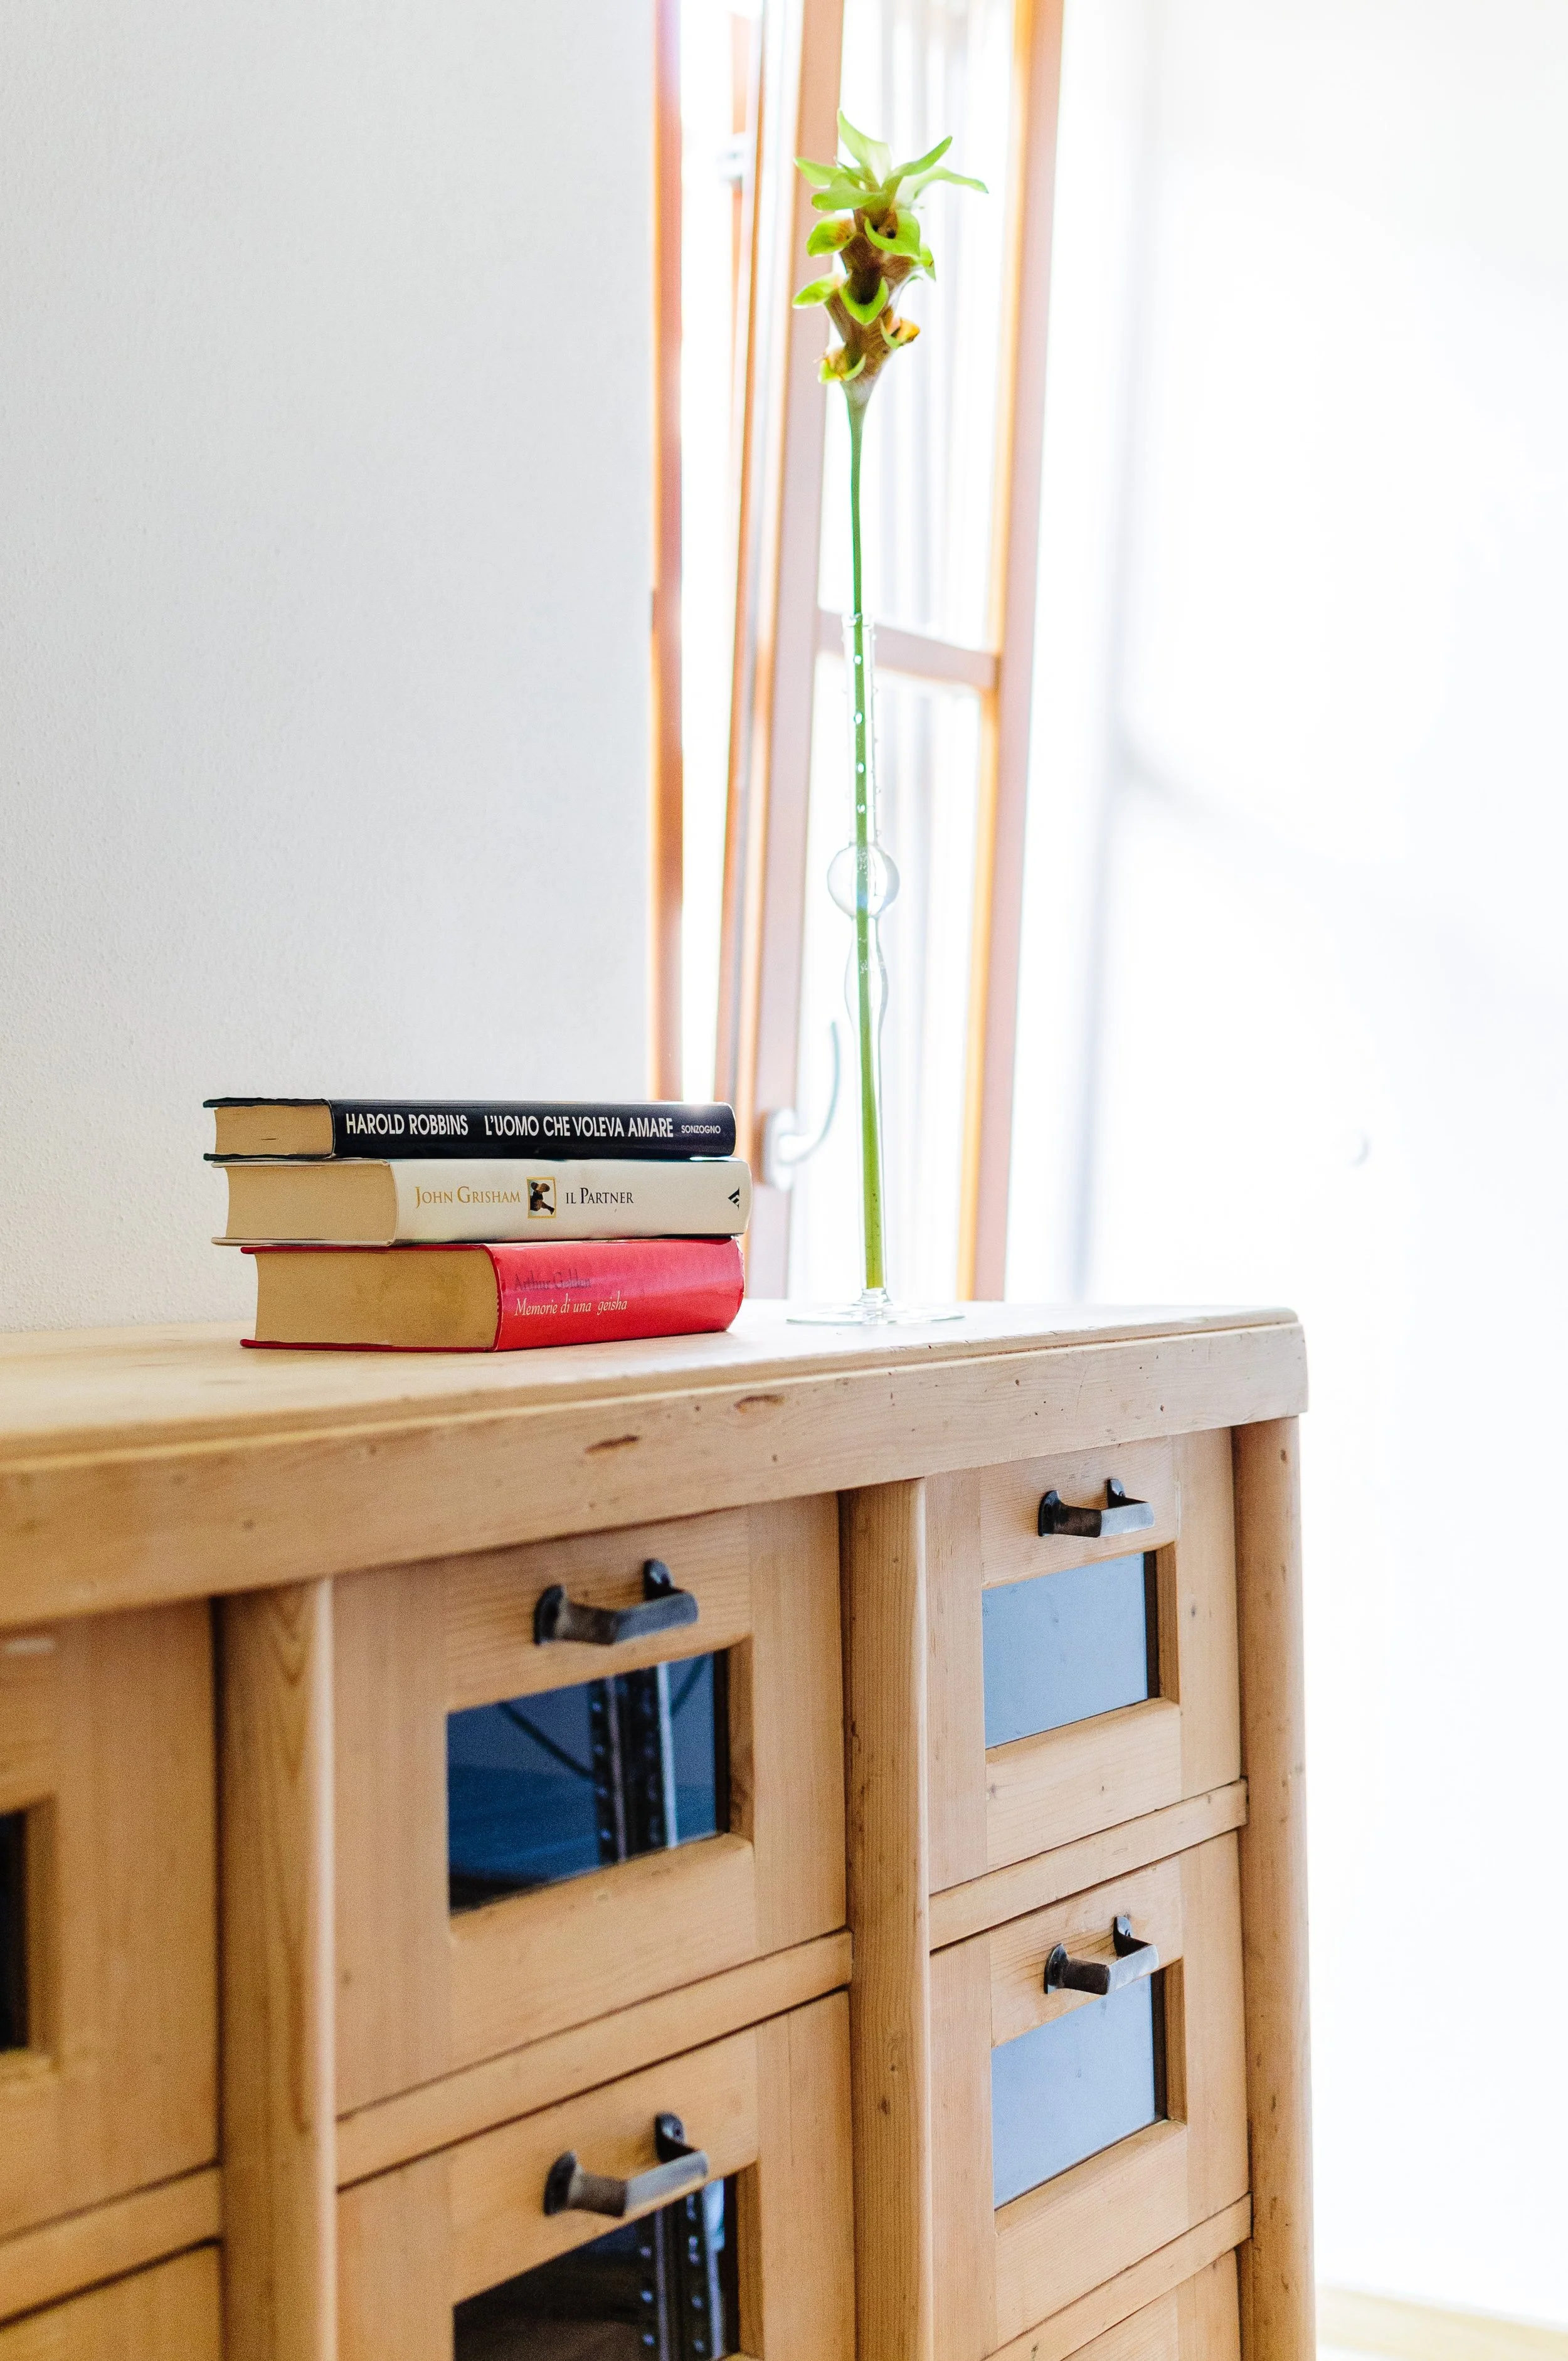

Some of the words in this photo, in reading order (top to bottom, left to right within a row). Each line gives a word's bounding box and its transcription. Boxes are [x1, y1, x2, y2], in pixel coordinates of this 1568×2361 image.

[346, 1113, 405, 1134] HAROLD
[408, 1114, 469, 1135] ROBBINS
[543, 1116, 570, 1136] CHE
[572, 1117, 624, 1137] VOLEVA
[628, 1118, 673, 1137] AMARE
[681, 1125, 721, 1134] SONZOGNO
[514, 1298, 558, 1316] Memorie
[560, 1292, 570, 1313] di
[573, 1302, 591, 1312] una
[596, 1290, 628, 1315] geisha
